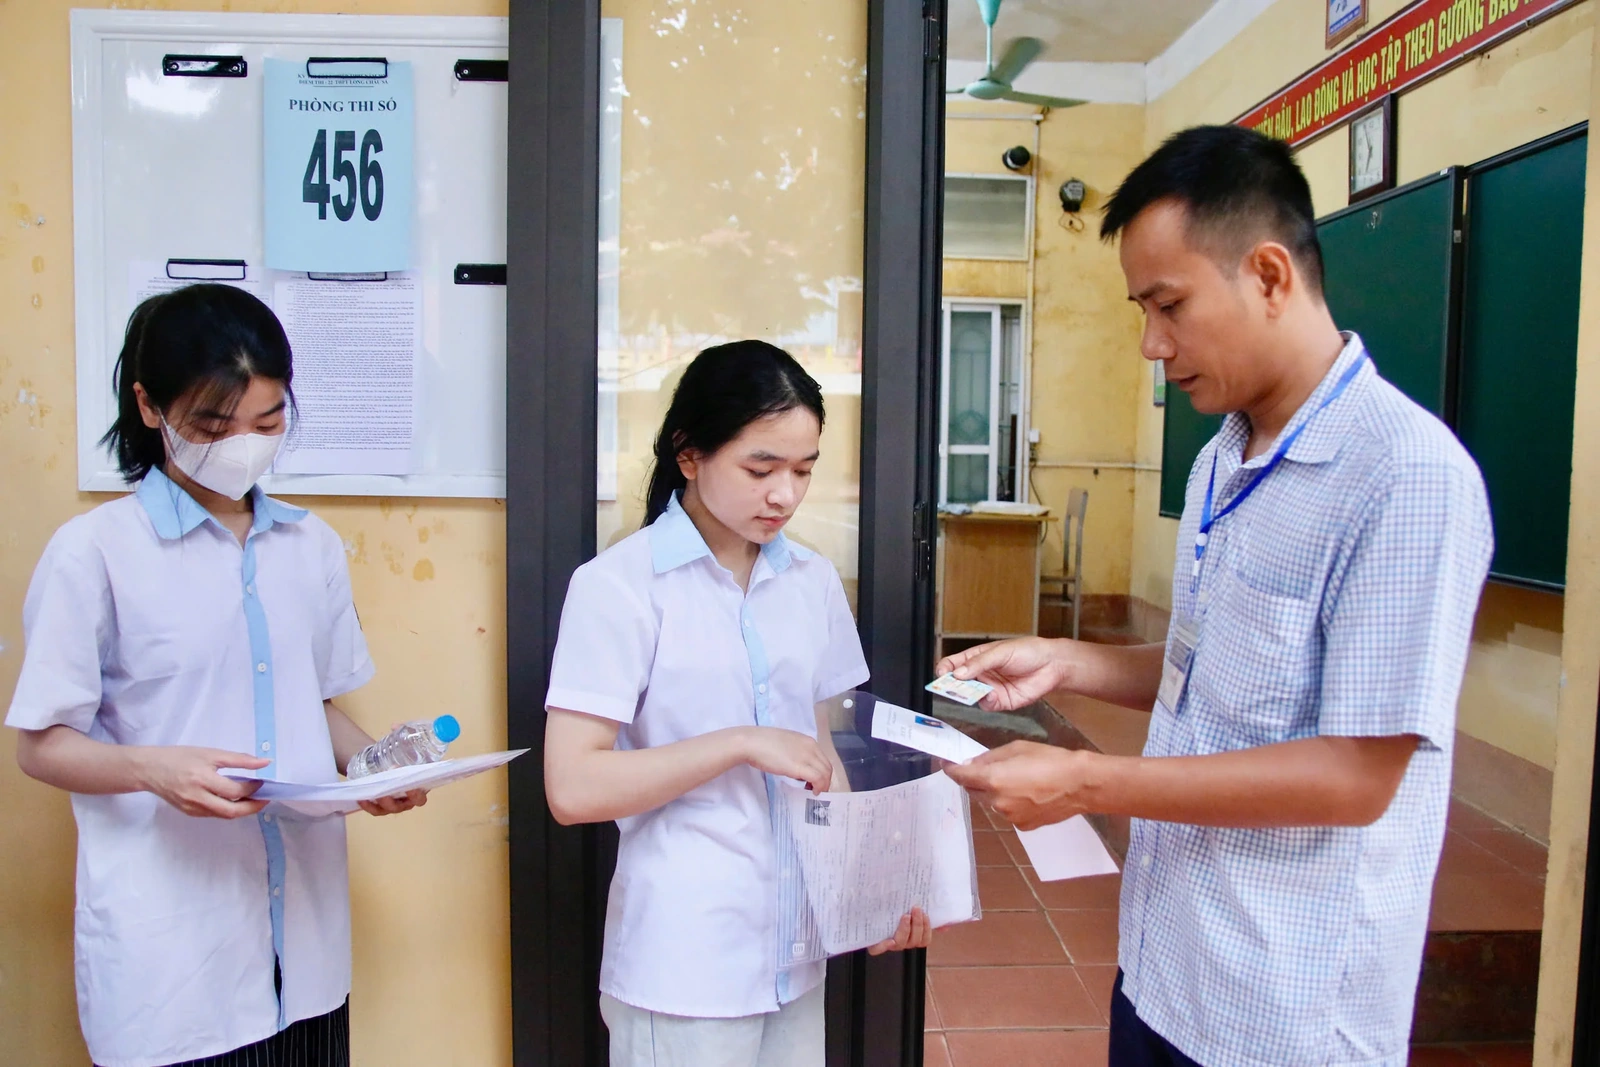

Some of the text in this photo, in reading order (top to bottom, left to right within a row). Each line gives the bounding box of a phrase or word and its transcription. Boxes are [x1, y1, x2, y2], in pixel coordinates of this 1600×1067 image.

[289, 96, 397, 112] PHÒNG THI SỐ
[1296, 92, 1312, 132] LAO
[1314, 77, 1339, 126] ĐỘNG
[1342, 58, 1354, 106] VÀ
[1357, 52, 1378, 102] HỌC
[1381, 35, 1401, 90] TẬP
[1405, 18, 1434, 71] THEO
[302, 128, 384, 222] 456
